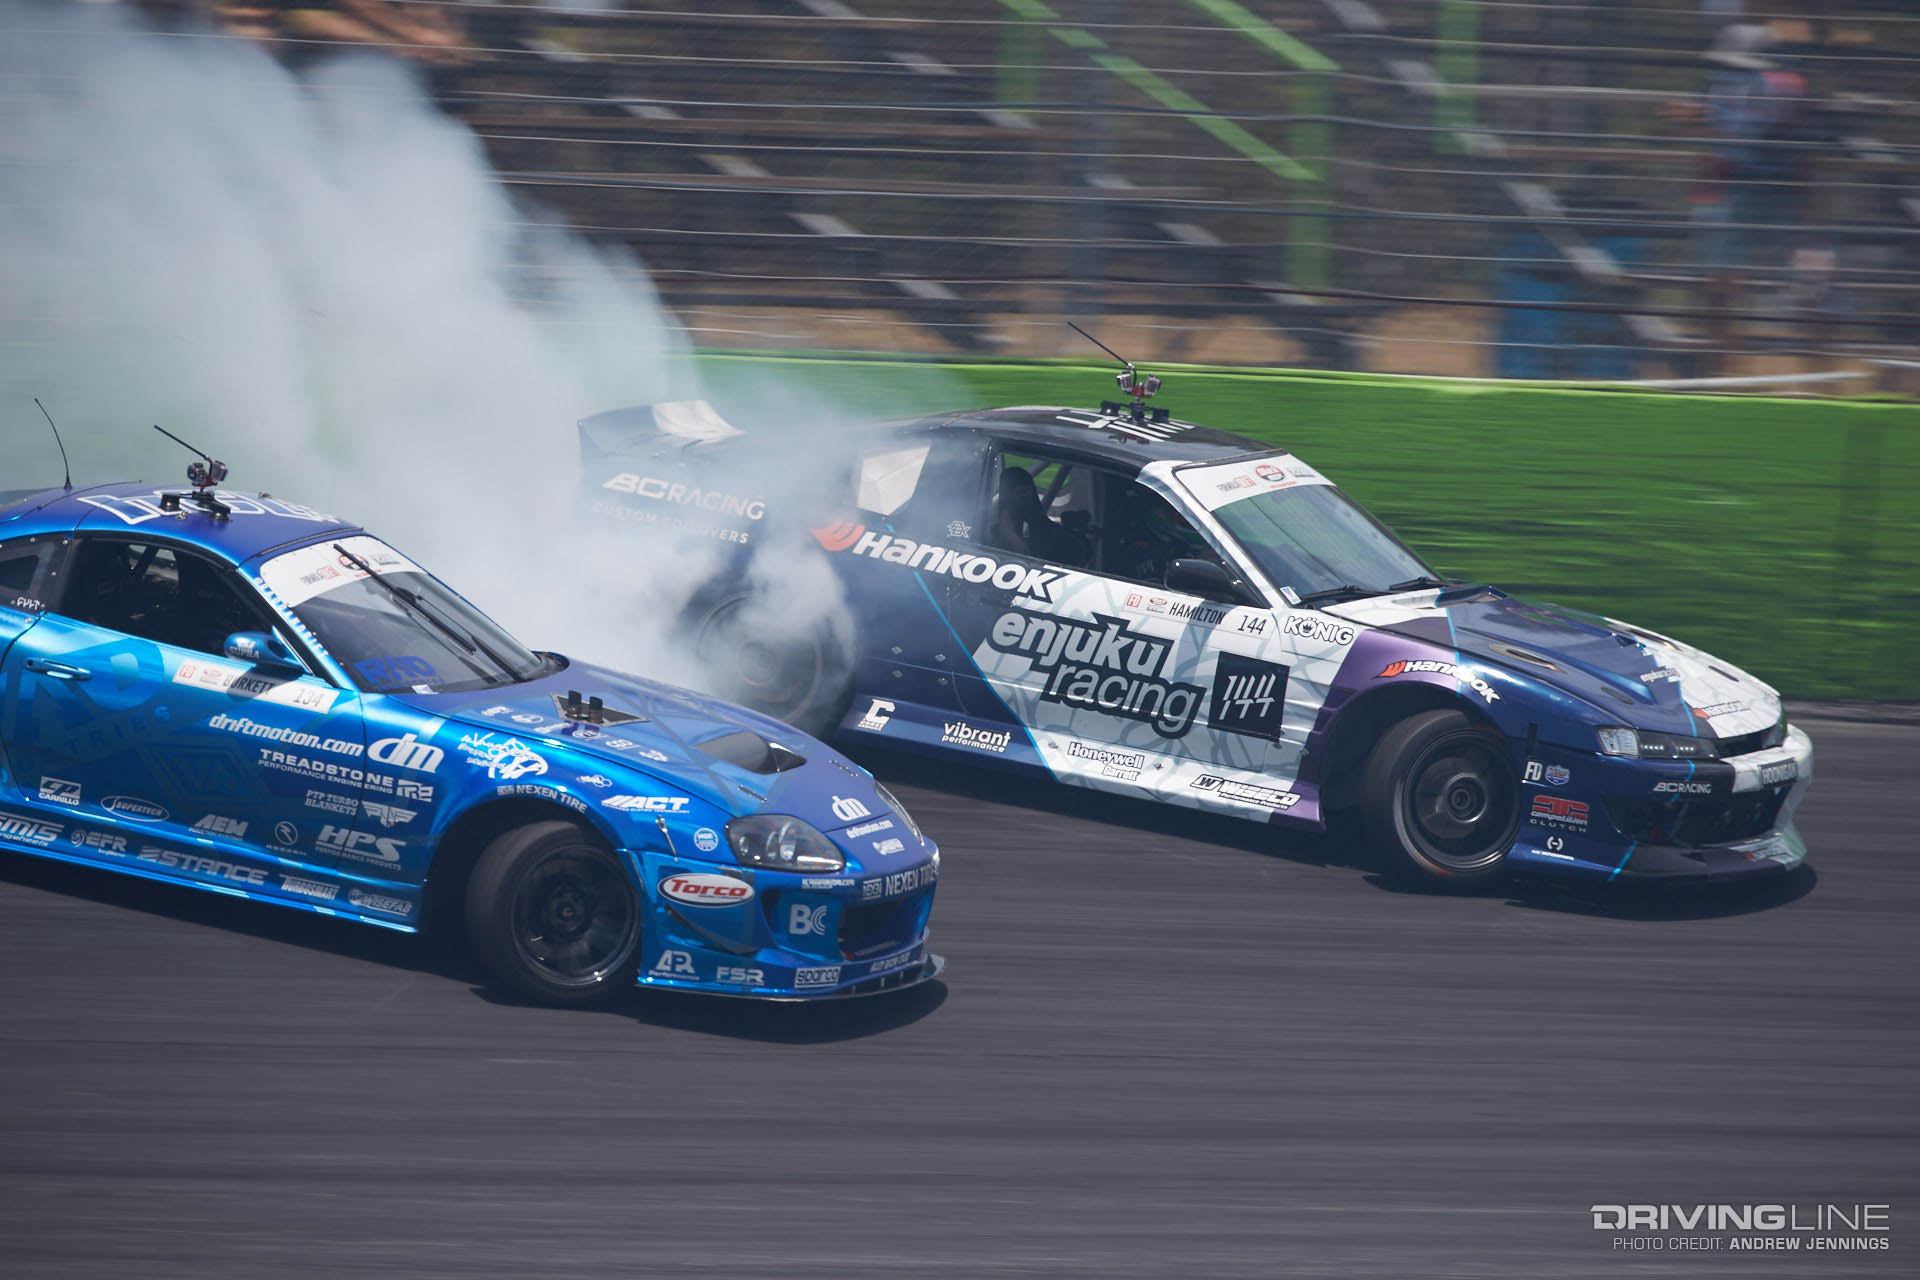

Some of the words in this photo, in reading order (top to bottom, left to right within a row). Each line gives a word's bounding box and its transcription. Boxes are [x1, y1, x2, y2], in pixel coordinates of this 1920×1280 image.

[1168, 602, 1226, 625] HAMILTON
[1237, 615, 1268, 635] 144
[992, 612, 1165, 676] enjuku
[222, 673, 276, 695] BURKETT
[1050, 663, 1197, 733] racing
[209, 714, 364, 757] driftmotion.com
[941, 734, 1006, 753] performance
[944, 722, 1011, 747] vibrant
[367, 733, 444, 773] dm
[1068, 741, 1145, 769] Honeywell
[258, 759, 326, 780] PERFORMANCE
[328, 774, 393, 794] ENGINEERING
[260, 749, 394, 788] TREADSTONE
[1102, 766, 1141, 781] Garrett
[1524, 761, 1543, 781] FD
[38, 792, 80, 806] CARRILLO
[327, 792, 359, 807] TURBO
[516, 784, 559, 800] NEXEN
[561, 795, 588, 814] TIRE
[1217, 780, 1302, 806] WISECO
[115, 801, 163, 817] SUPERTECH
[304, 798, 358, 817] BLANKETS
[194, 814, 249, 838] AEM
[1530, 818, 1587, 832] CLUTCH
[85, 831, 128, 852] EFR
[315, 824, 407, 862] HPS
[671, 879, 748, 897] Torco
[885, 870, 918, 896] NEXEN
[796, 967, 839, 984] sparco
